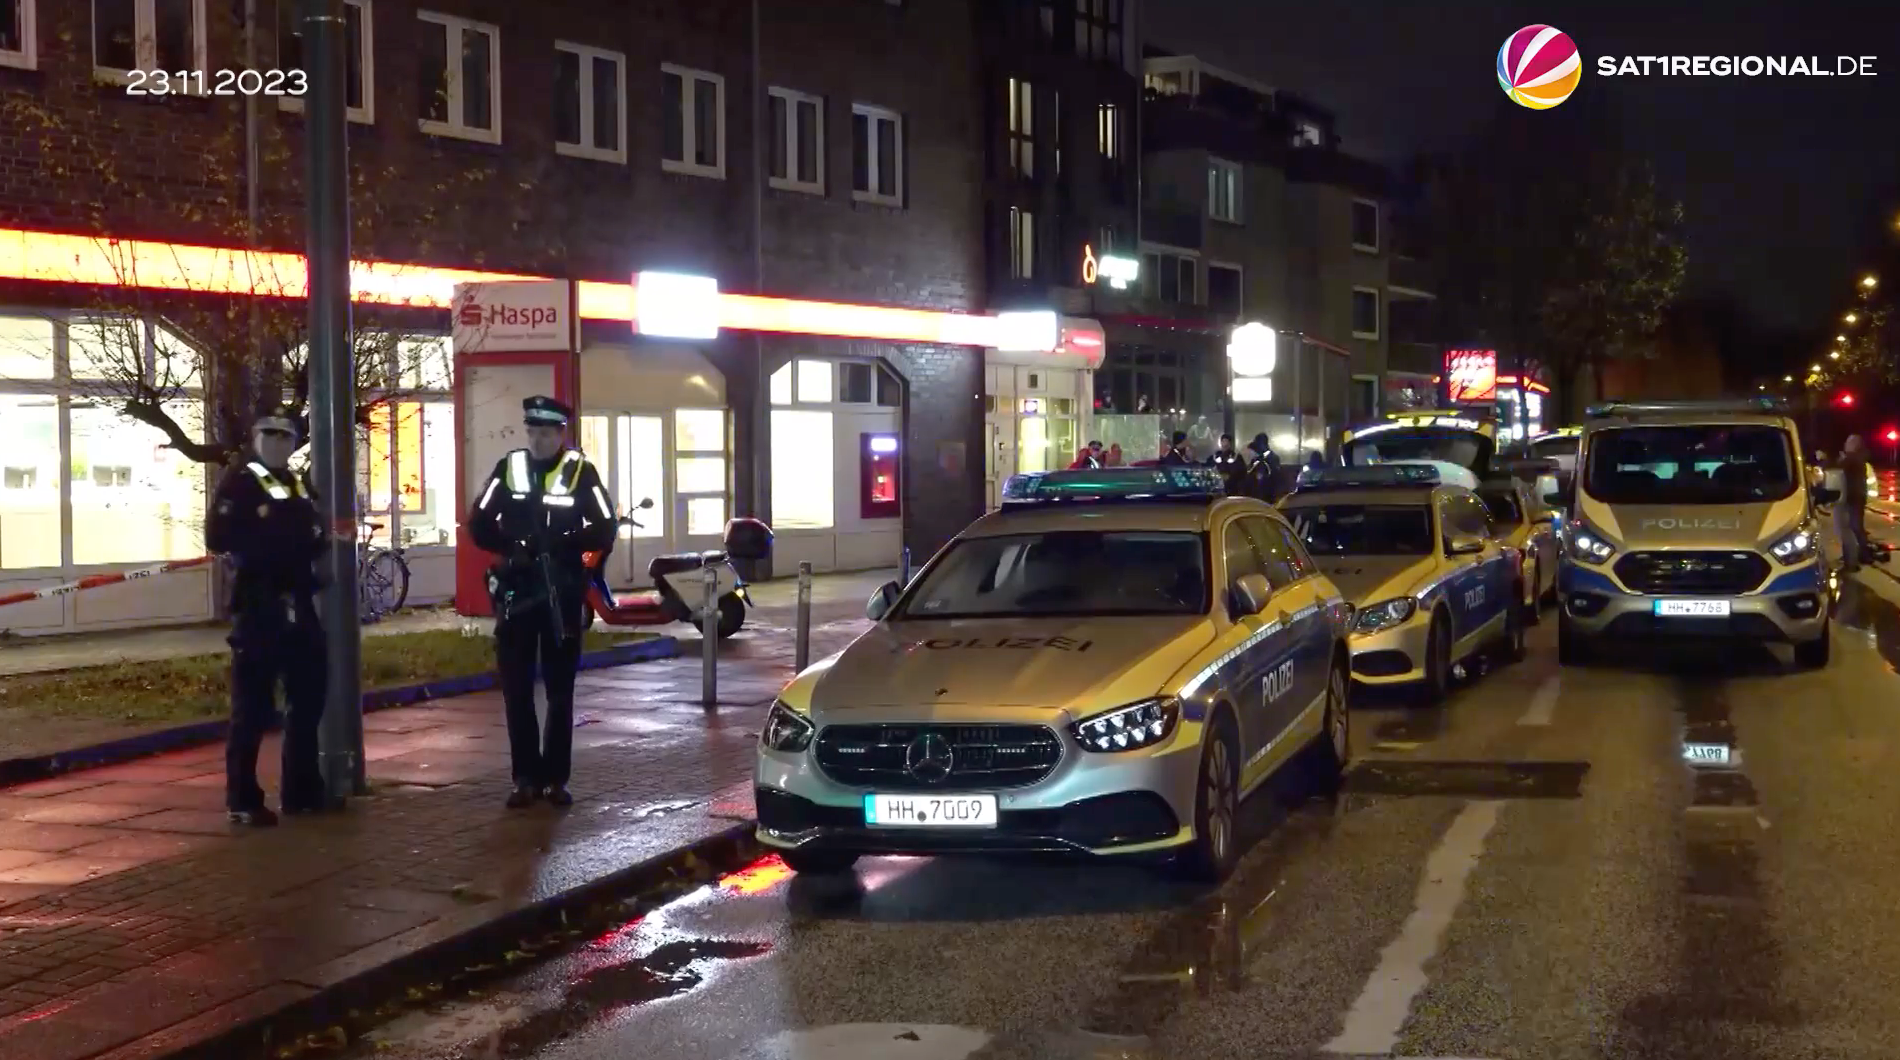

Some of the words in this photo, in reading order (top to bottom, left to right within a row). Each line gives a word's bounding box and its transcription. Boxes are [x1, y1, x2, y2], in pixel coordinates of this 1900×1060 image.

[490, 304, 557, 329] Haspa
[1642, 518, 1740, 530] POLIZEI
[908, 636, 1094, 653] OLIZEI
[1262, 658, 1294, 707] POLIZEI
[888, 800, 915, 820] HH
[930, 799, 983, 820] 7009
